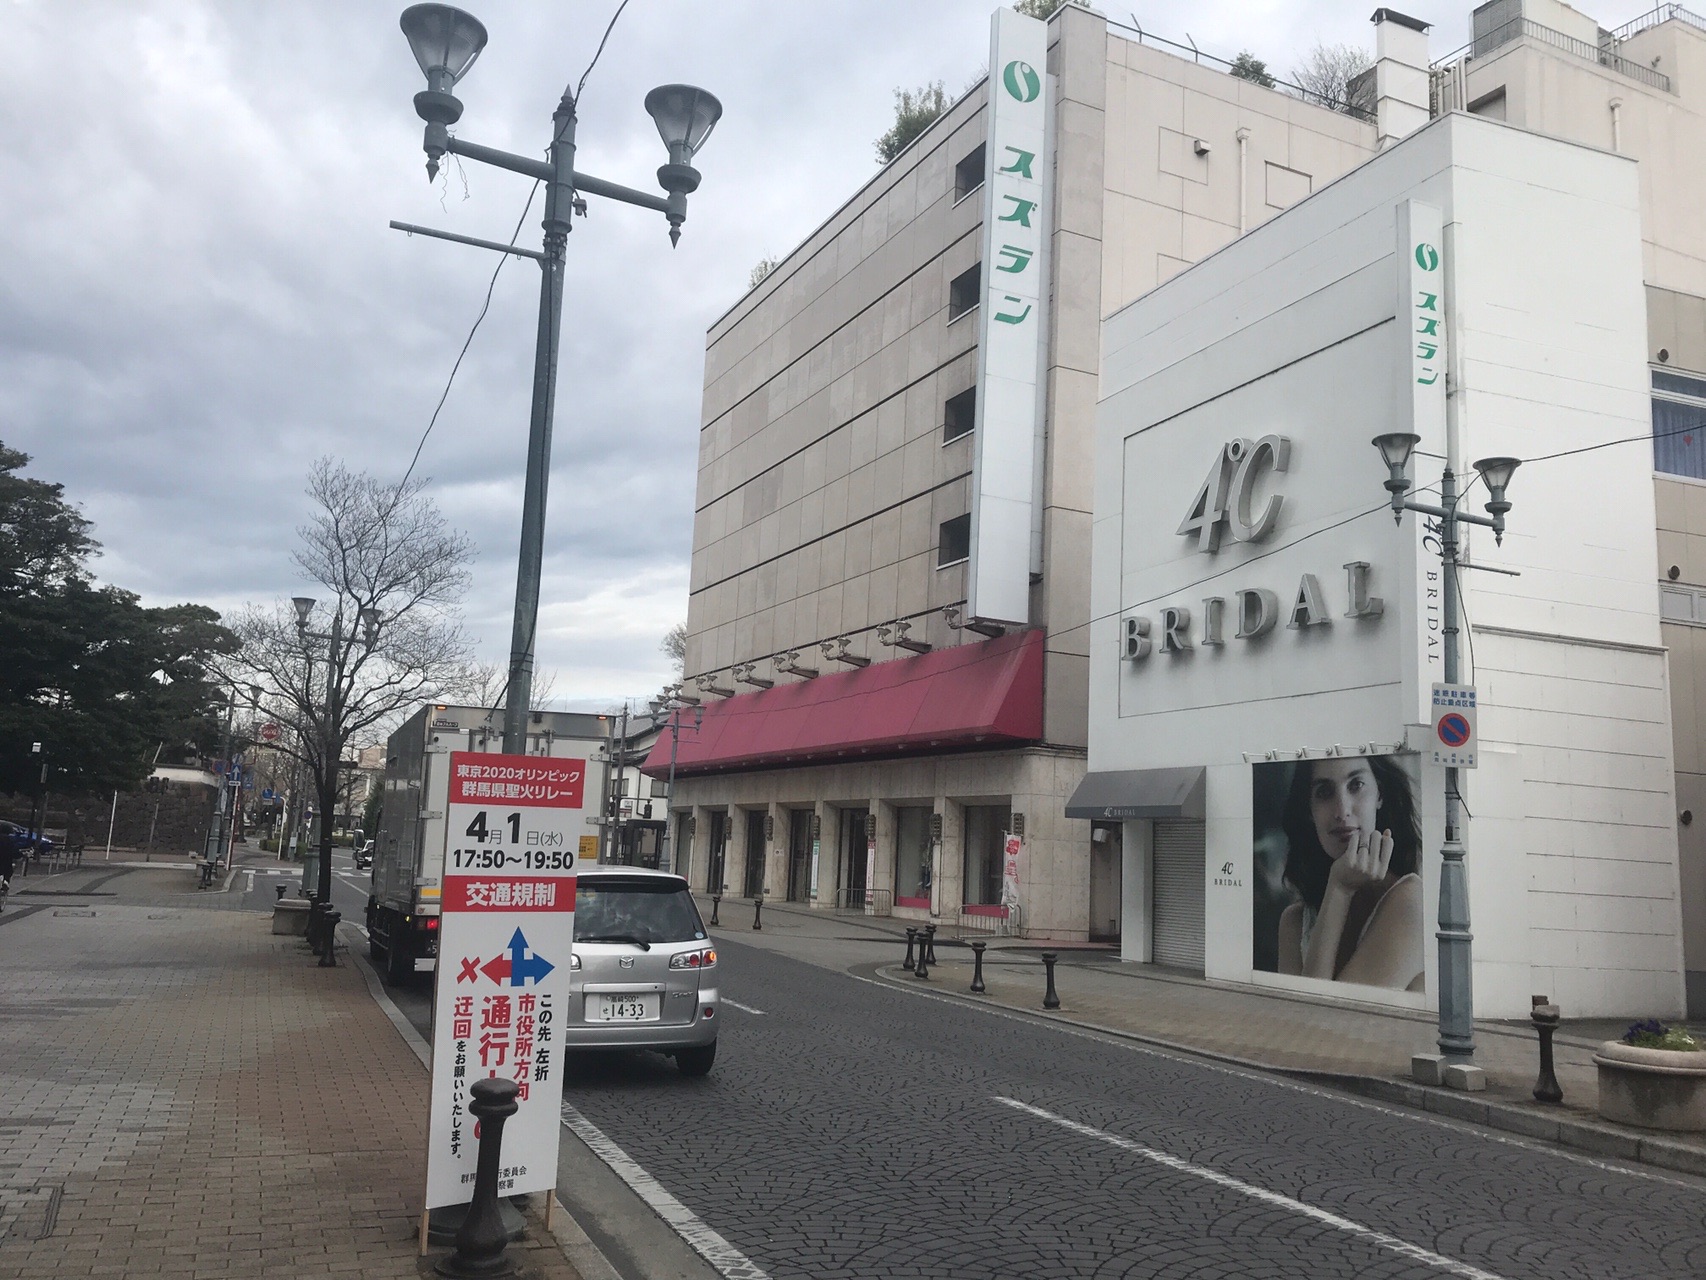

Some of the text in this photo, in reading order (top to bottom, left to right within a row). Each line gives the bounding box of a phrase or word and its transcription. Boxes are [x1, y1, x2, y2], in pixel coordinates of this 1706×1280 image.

[994, 145, 1038, 325] スズラン
[1415, 291, 1441, 385] スズラン
[1121, 560, 1384, 661] BRIDAL
[1426, 570, 1439, 664] BRIDAL
[456, 764, 580, 783] 東京2020オリンピック
[462, 781, 573, 800] 群馬県聖火リレー
[465, 882, 557, 908] 交通規制
[1214, 878, 1243, 888] BRIDAL
[612, 1003, 644, 1017] 14-33
[450, 996, 474, 1159] 迂回をお願いいたします。
[513, 993, 536, 1102] 市役所方向
[461, 1165, 528, 1184] 群馬委員会
